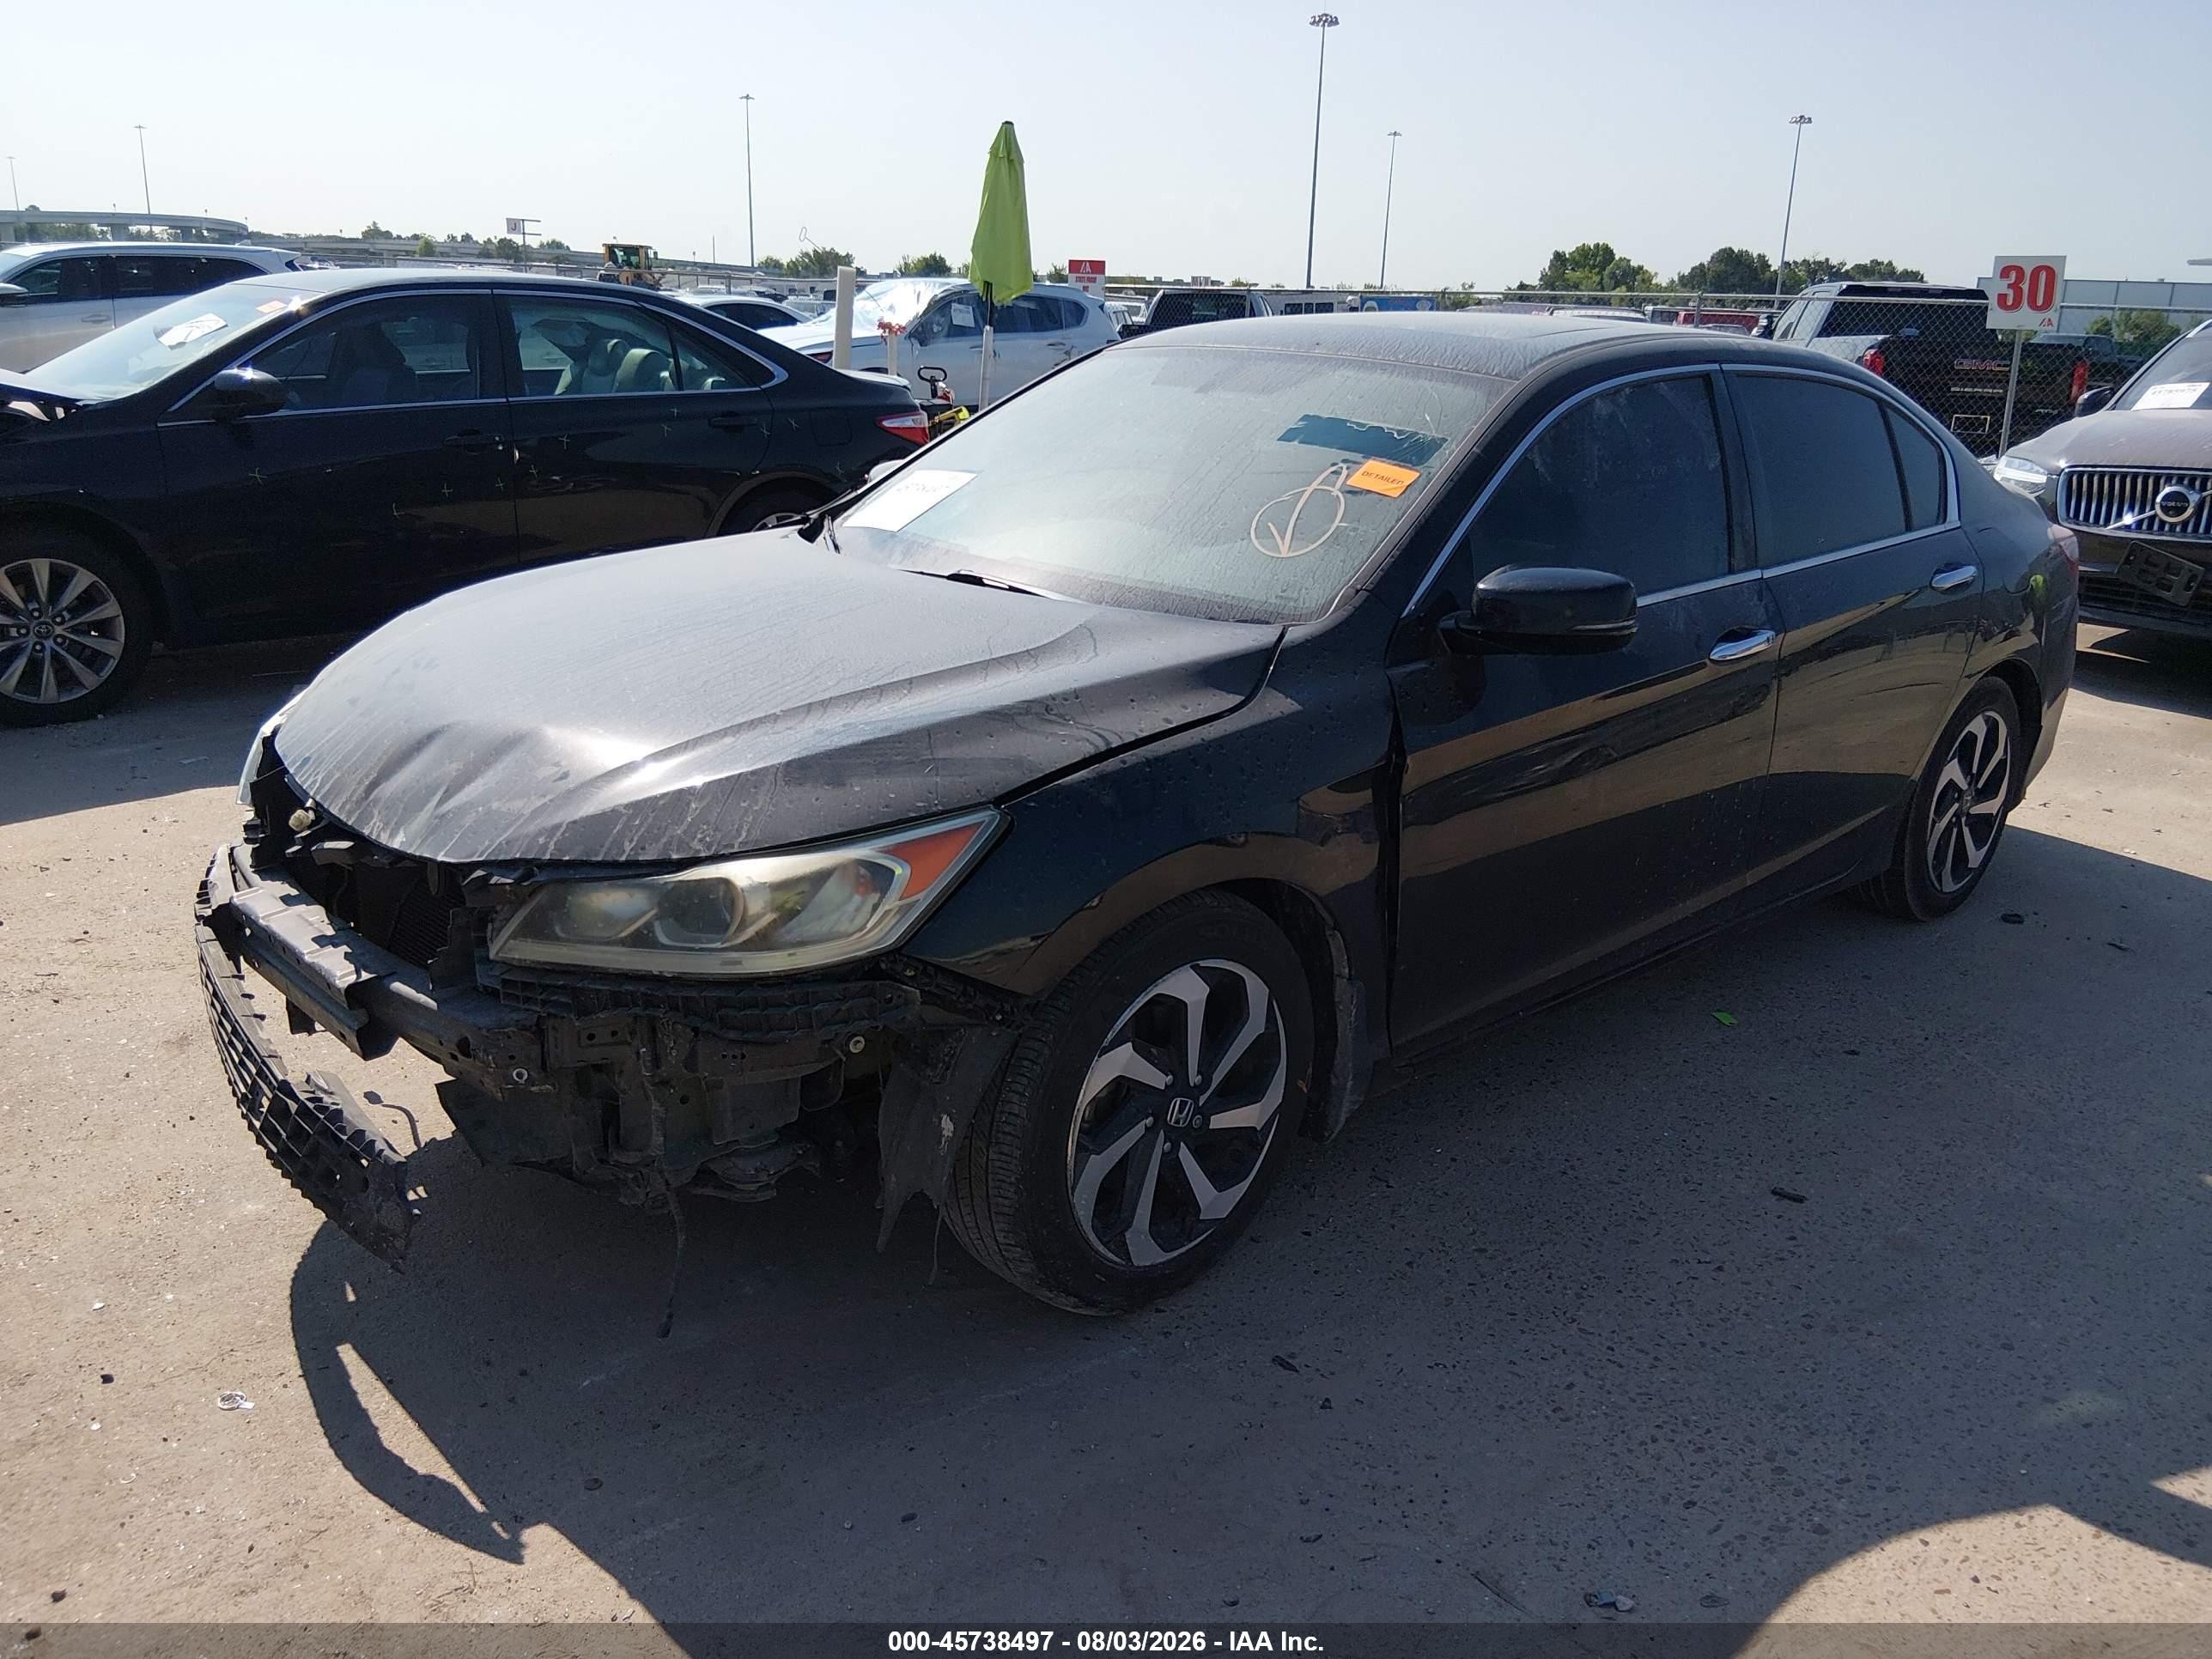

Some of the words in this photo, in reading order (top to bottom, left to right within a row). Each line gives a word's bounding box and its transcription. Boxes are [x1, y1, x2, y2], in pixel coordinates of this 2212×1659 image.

[511, 222, 517, 231] J
[1996, 264, 2057, 313] 30
[1954, 358, 2011, 371] GMC
